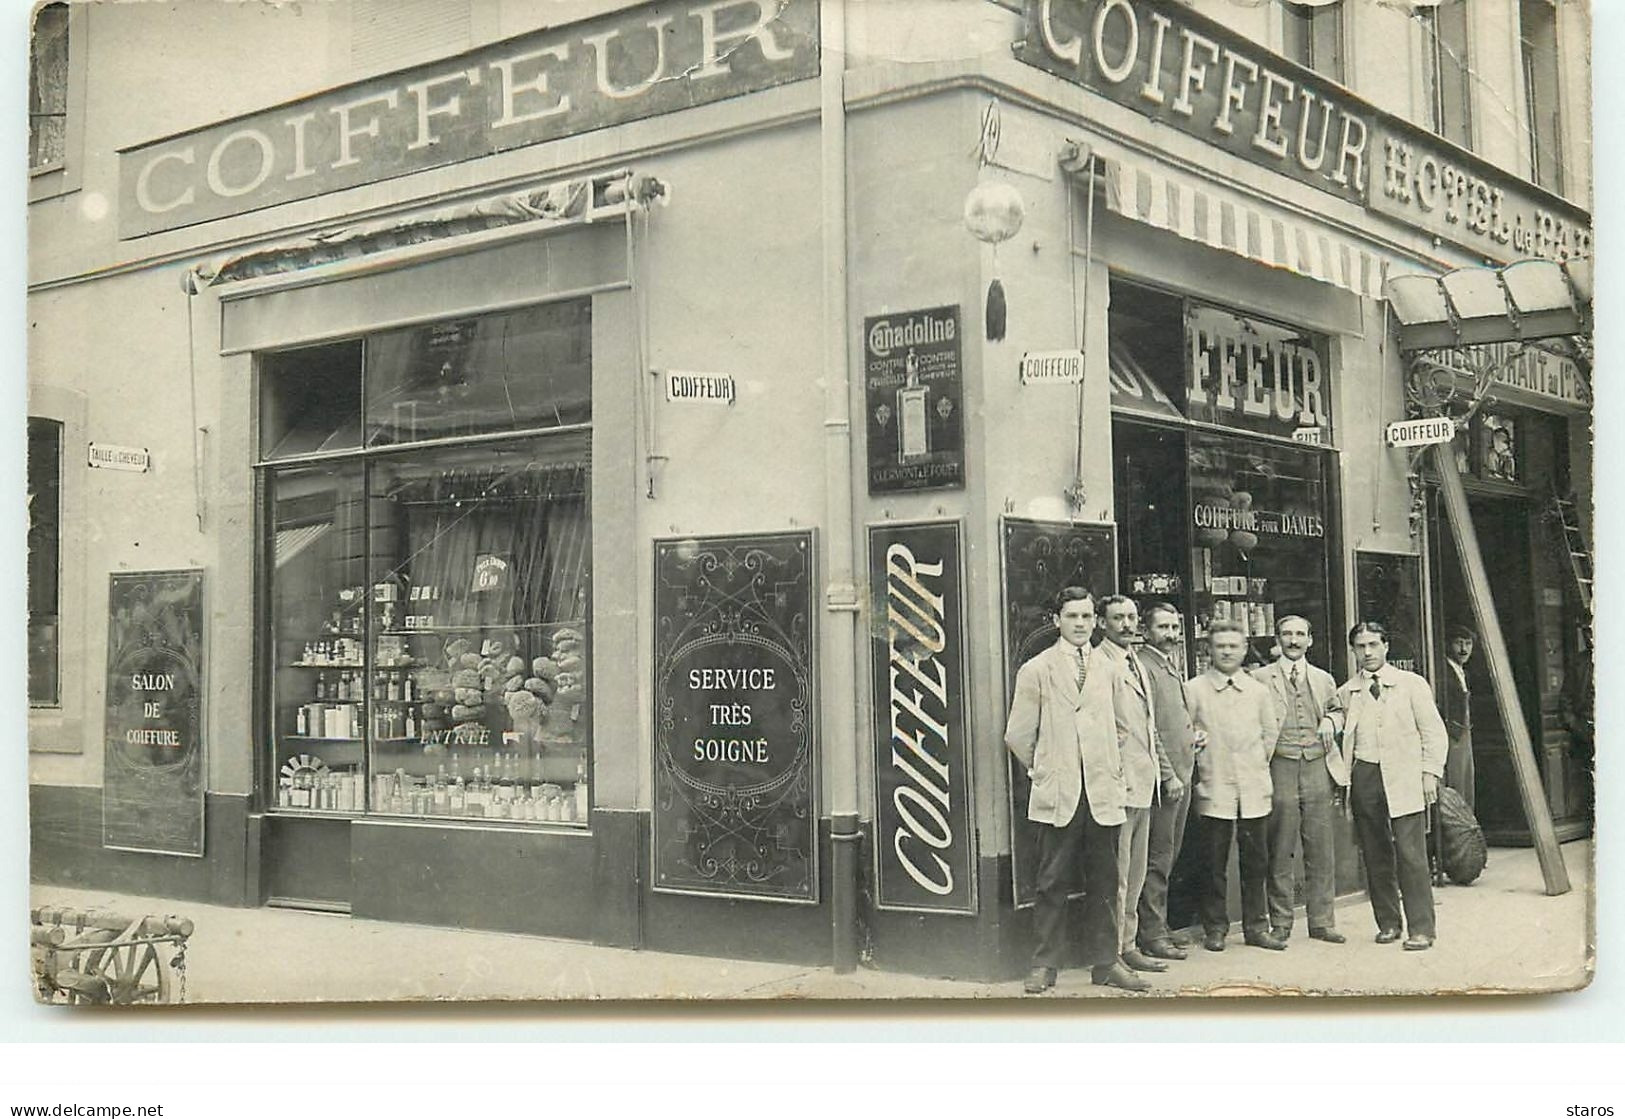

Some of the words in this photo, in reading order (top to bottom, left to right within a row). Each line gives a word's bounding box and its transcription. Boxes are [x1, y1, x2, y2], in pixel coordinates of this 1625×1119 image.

[137, 0, 795, 213] COIFFEUR
[1042, 0, 1367, 193] COIFFEUR
[870, 316, 955, 357] Canadoline
[1026, 357, 1079, 378] COIFFEUR
[671, 376, 730, 399] COIFFEUR
[1391, 422, 1450, 442] COIFFEUR
[1194, 504, 1260, 532] COIFFURE
[1282, 513, 1324, 537] DAMES
[132, 674, 174, 691] SALON
[689, 667, 776, 690] SERVICE
[144, 702, 160, 718] DE
[710, 702, 751, 725] TRÈS
[887, 543, 954, 895] COIFFEUR
[127, 729, 180, 746] COIFFURE
[694, 738, 769, 763] SOIGNÉ
